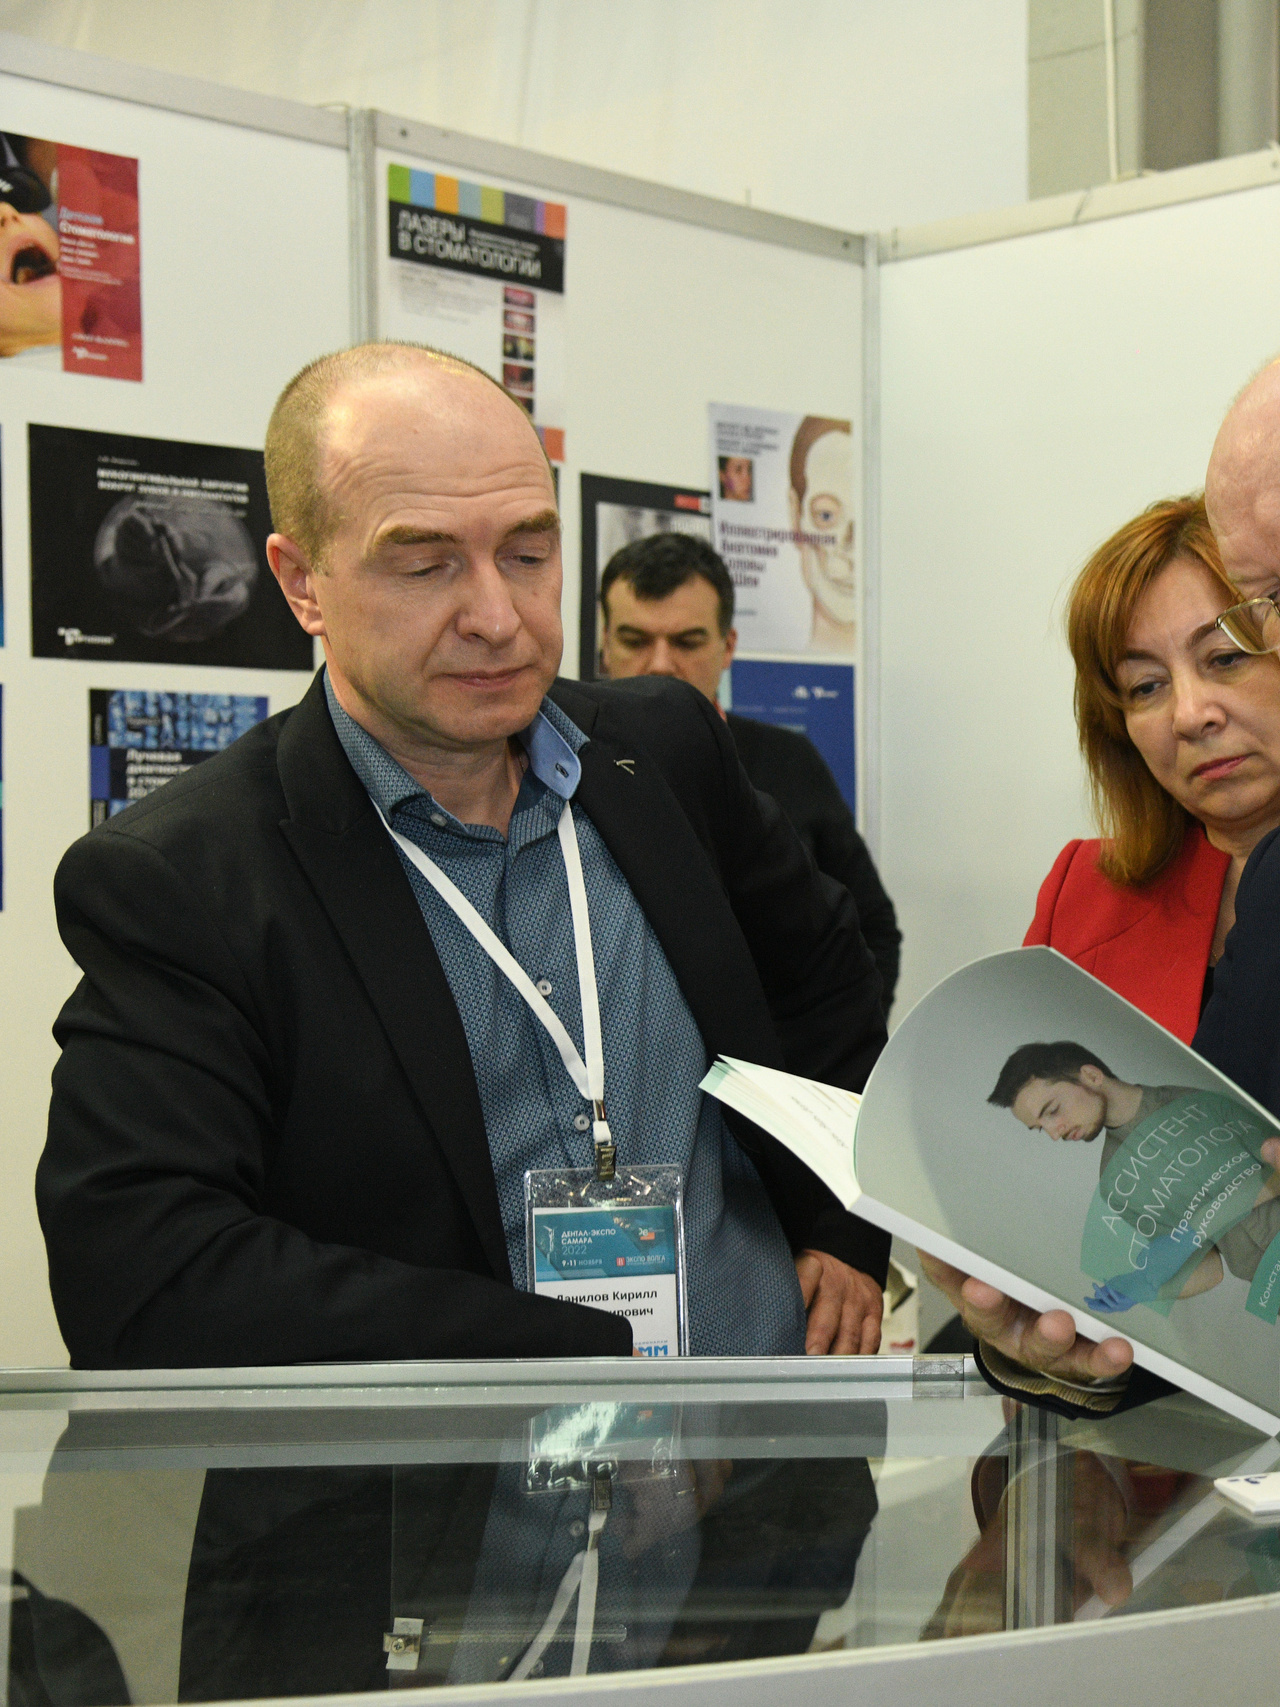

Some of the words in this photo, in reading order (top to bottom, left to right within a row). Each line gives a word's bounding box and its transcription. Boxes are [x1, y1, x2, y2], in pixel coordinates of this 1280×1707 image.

[398, 209, 466, 242] ЛАЗЕРЫ
[398, 230, 412, 252] В
[413, 233, 542, 279] СТОМАТОЛОГИИ
[1102, 1103, 1209, 1235] АССИСТЕНТ
[1128, 1118, 1258, 1271] СТОМАТОЛОГА
[1170, 1152, 1250, 1243] Практическое
[1192, 1163, 1262, 1248] руководство
[561, 1237, 593, 1245] САМАРА
[562, 1245, 588, 1256] 2022
[612, 1290, 658, 1302] Кирилл
